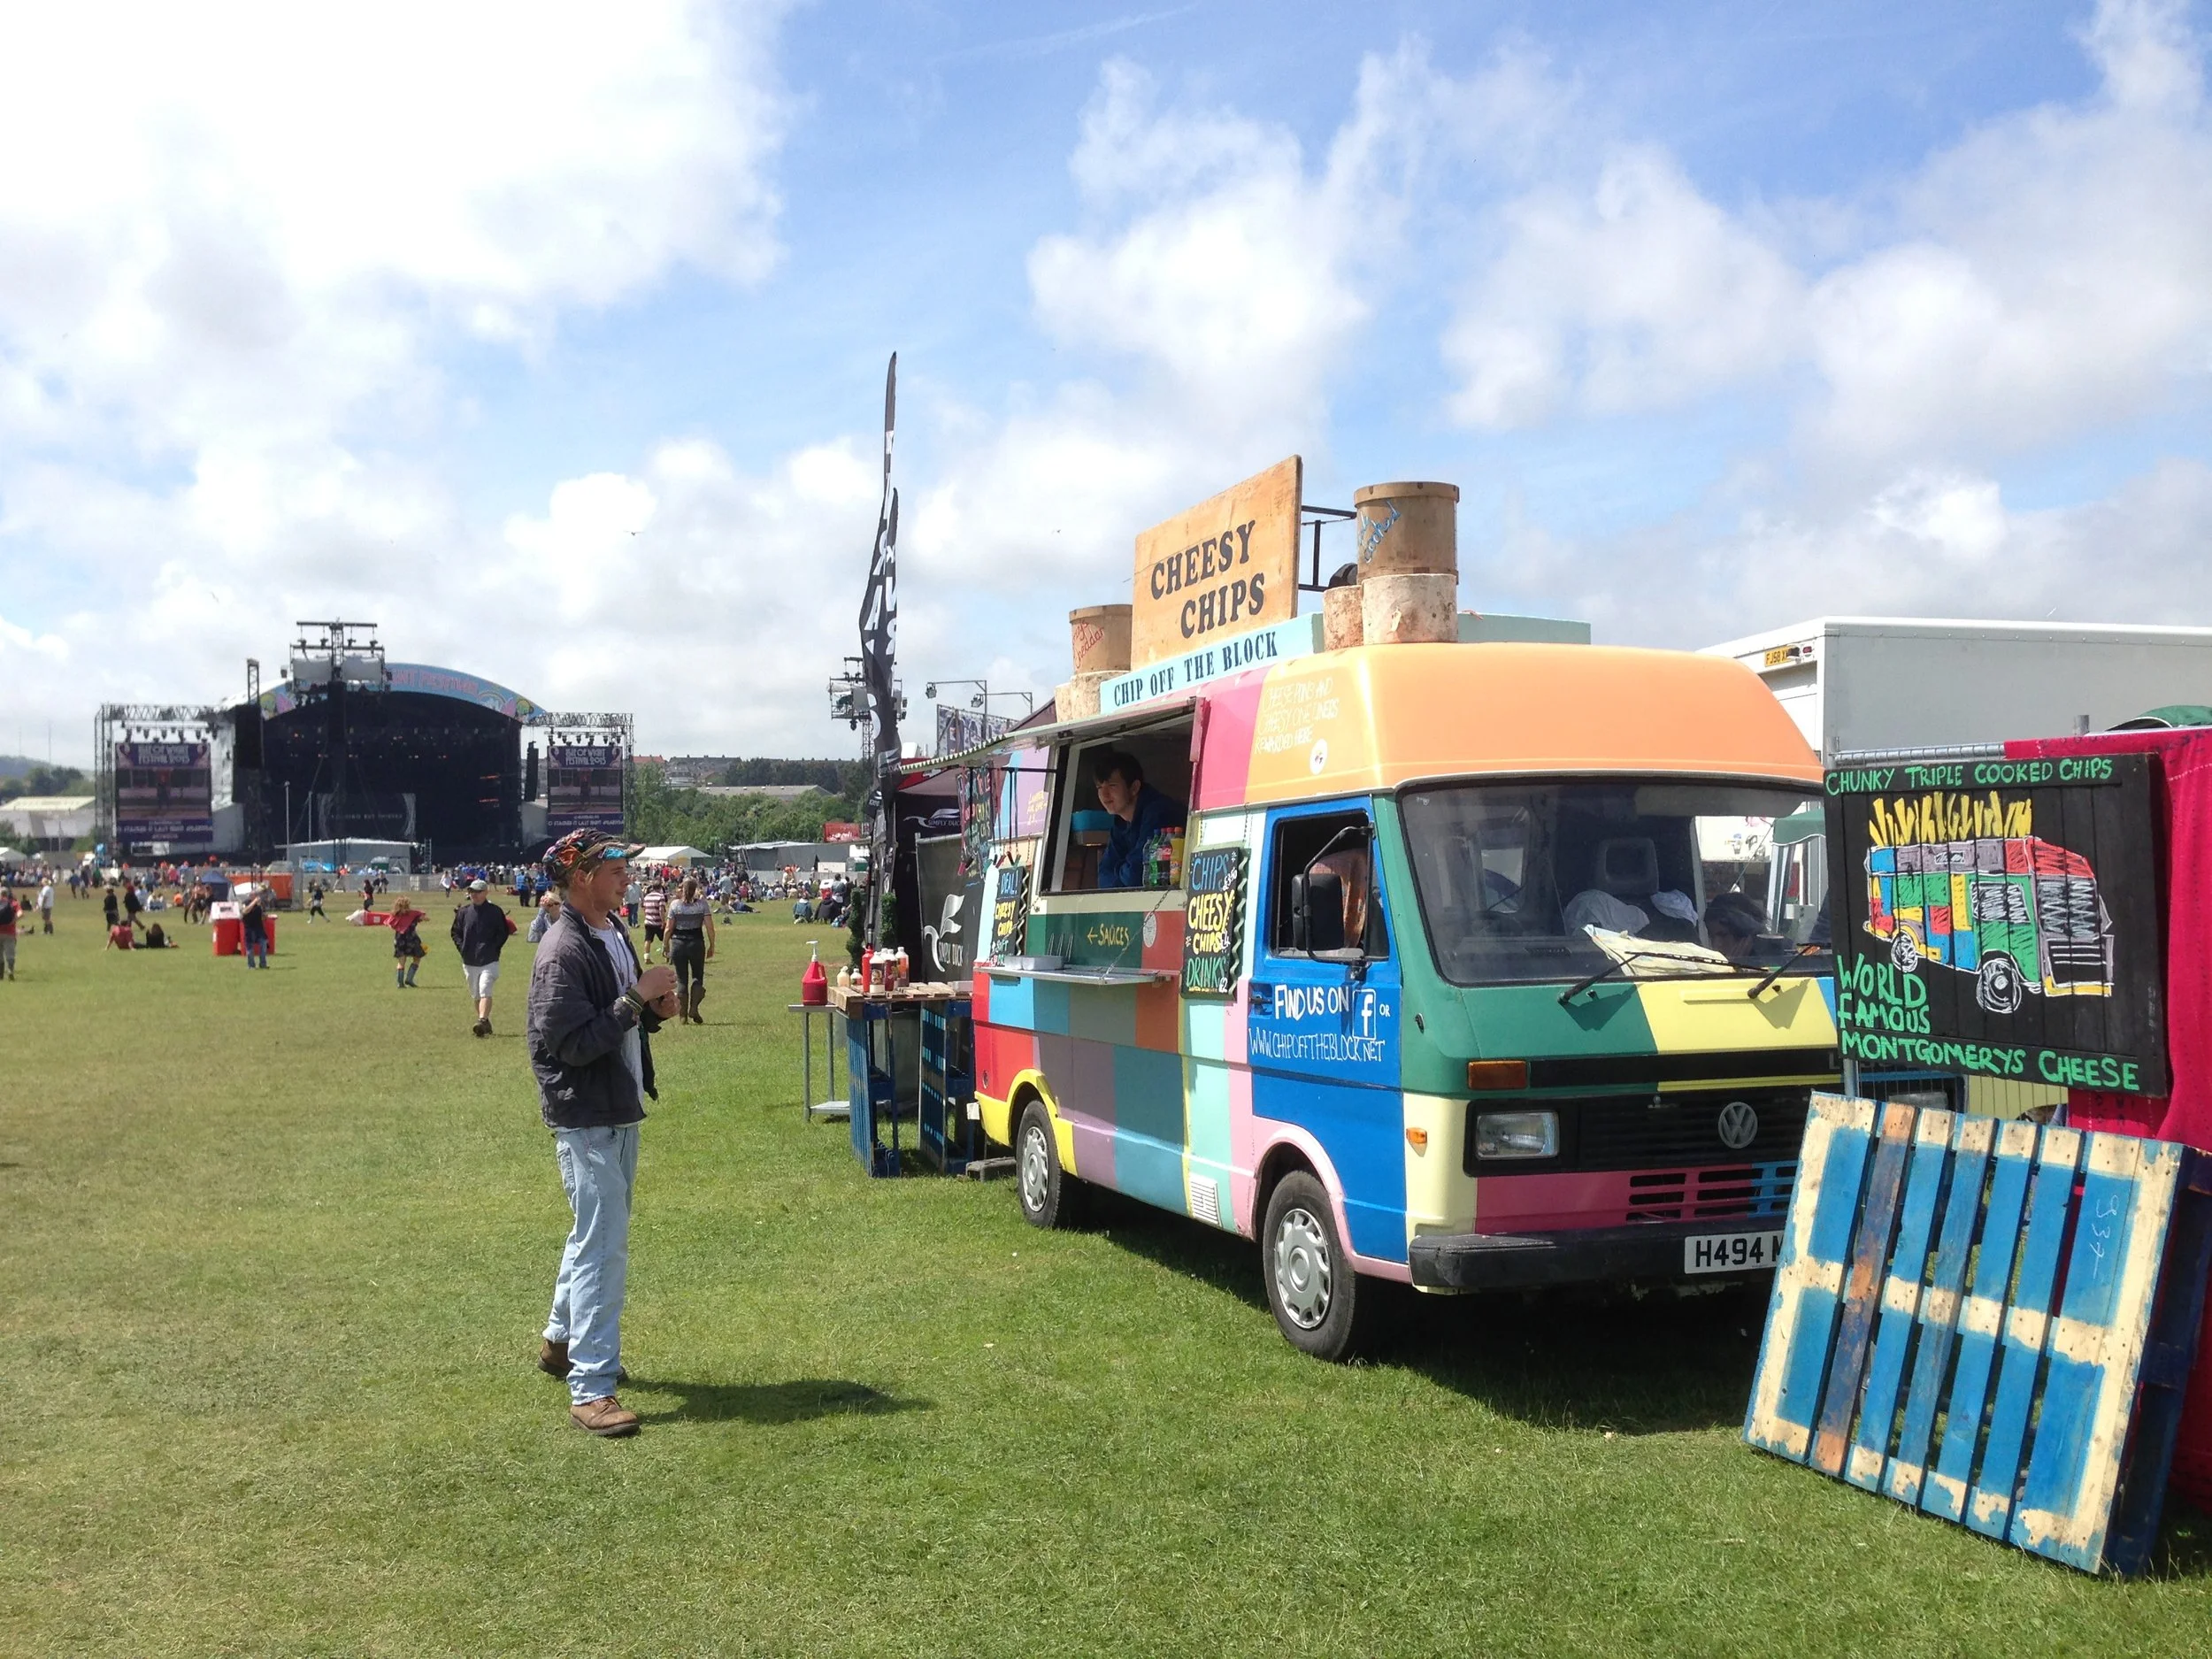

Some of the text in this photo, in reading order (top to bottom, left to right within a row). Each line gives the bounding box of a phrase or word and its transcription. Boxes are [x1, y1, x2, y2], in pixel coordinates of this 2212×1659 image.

[1150, 519, 1256, 600] CHEESY
[1180, 572, 1264, 639] CHIPS
[1114, 631, 1278, 707] CHIP OFF THE BLOCK
[1294, 725, 1314, 745] HERE
[1826, 758, 2113, 795] CHUNKY TRIPLE COOKED CHIPS
[1193, 854, 1229, 891] CHIPS
[1188, 888, 1235, 934] CHEESY
[1098, 923, 1130, 947] SAUCES
[1193, 929, 1221, 955] CHIPS
[1187, 956, 1229, 987] DRINKS
[1837, 953, 1927, 1009] WORLD
[1275, 984, 1306, 1021] FIND
[1306, 987, 1325, 1016] US
[1327, 986, 1349, 1014] ON
[1379, 1003, 1391, 1018] OR
[1838, 993, 1932, 1034] FAMOUS
[1841, 1030, 2027, 1075] MONTGOMERYS
[2038, 1050, 2140, 1091] CHEESE
[1696, 1237, 1764, 1268] H494
